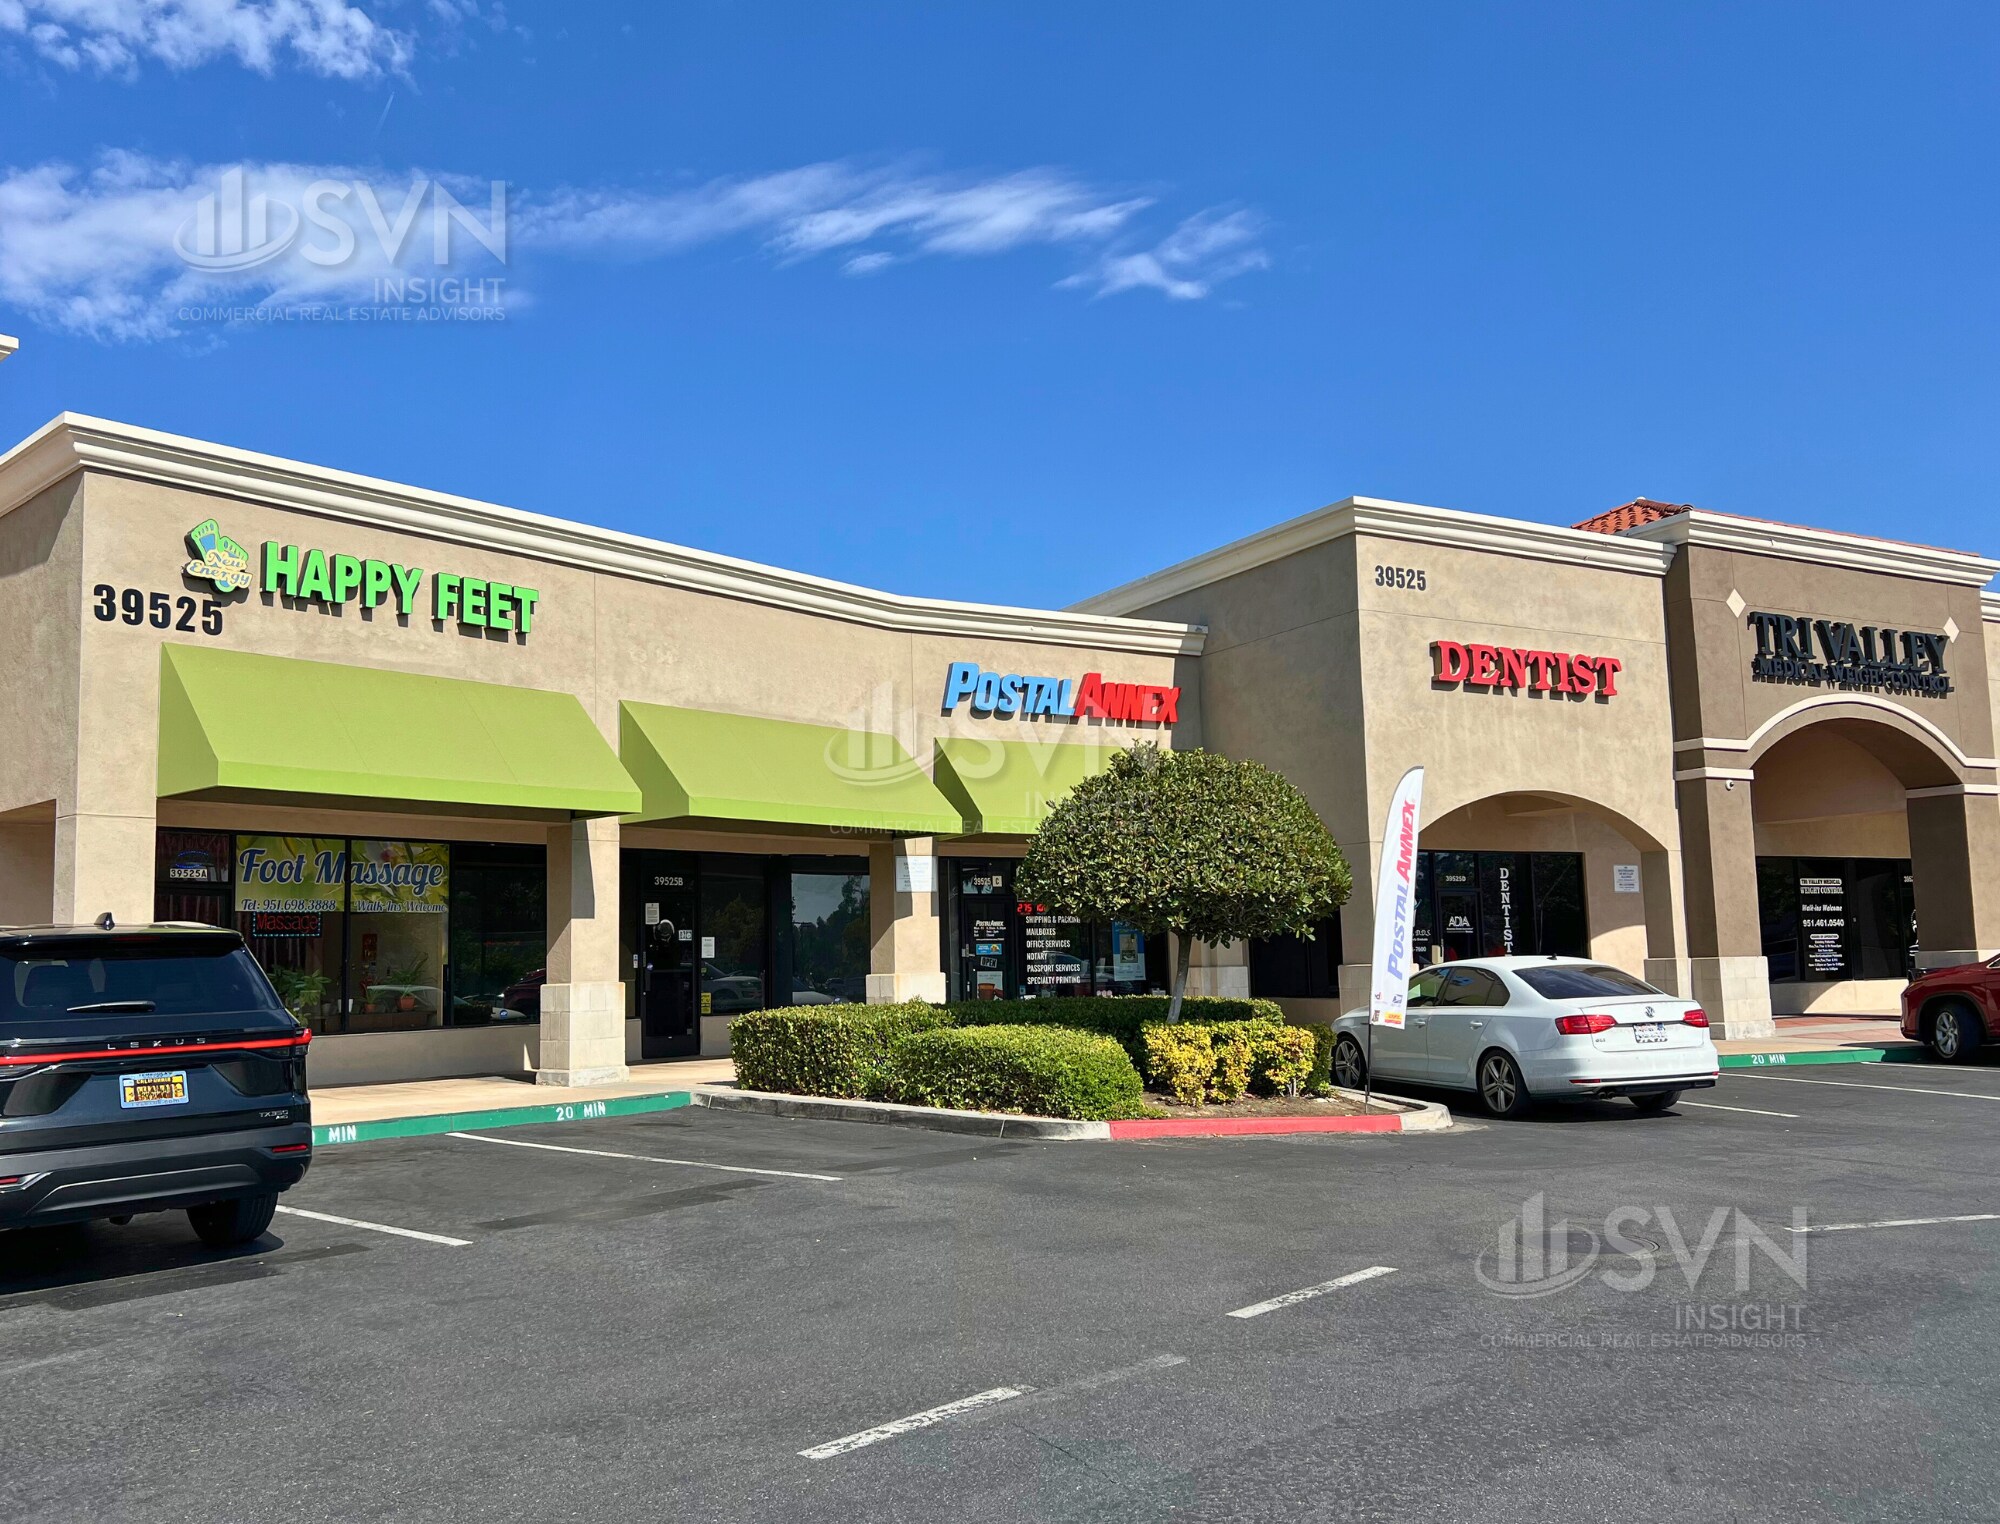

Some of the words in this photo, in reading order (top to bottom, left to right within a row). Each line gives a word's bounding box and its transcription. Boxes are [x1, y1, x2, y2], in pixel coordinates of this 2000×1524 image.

[207, 550, 244, 568] New
[190, 561, 250, 585] Energy
[1374, 565, 1427, 592] 39525
[260, 540, 424, 614] HAPPY
[432, 571, 540, 634] FEET
[93, 583, 223, 636] 39525
[1748, 611, 1816, 660] TRI
[1814, 619, 1950, 674] VALLEY
[1430, 639, 1623, 697] DENTIST
[1753, 655, 1829, 682] MEDICAL
[1830, 663, 1888, 687] WEIGHT
[1887, 669, 1955, 693] CONTROL
[170, 869, 207, 878] 39525A
[239, 848, 307, 885] Foot
[314, 850, 445, 898] Massage
[654, 876, 684, 887] 39525B
[241, 899, 260, 911] Tel:
[262, 899, 337, 911] 951.698.3888
[1499, 867, 1514, 955] DENTIST
[1026, 915, 1051, 924] SHIPPING
[1026, 928, 1056, 936] MAILBOXES
[1026, 940, 1045, 948] OFFICE
[1045, 940, 1071, 948] SERVICES
[1026, 952, 1048, 961] NOTARY
[1027, 964, 1054, 973] PASSPORT
[1055, 963, 1081, 972] SERVICES
[1027, 976, 1055, 985] SPECIALTY
[1056, 976, 1081, 984] PRINTING
[107, 1037, 206, 1050] LEXUS
[1751, 1054, 1765, 1065] 20
[1769, 1053, 1786, 1064] MIN
[556, 1105, 574, 1121] 20
[583, 1101, 606, 1118] MIN
[328, 1124, 357, 1143] MIN
